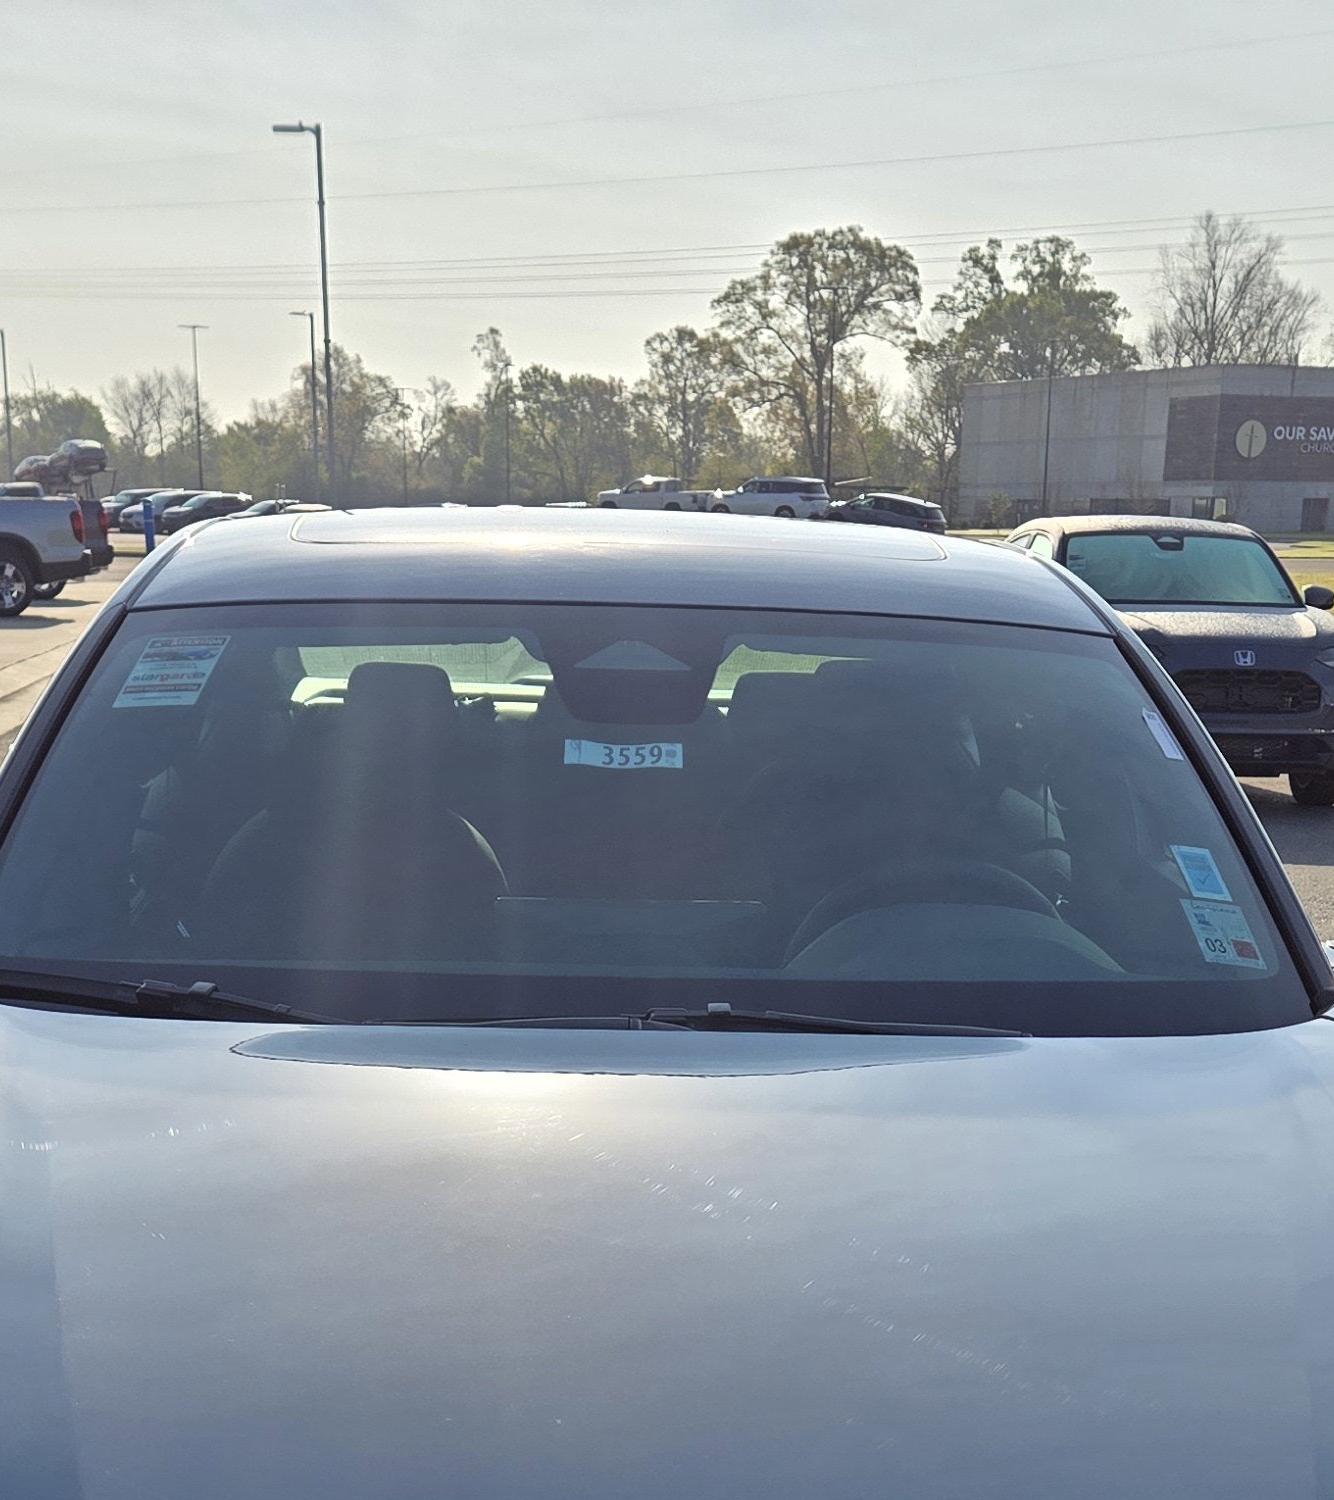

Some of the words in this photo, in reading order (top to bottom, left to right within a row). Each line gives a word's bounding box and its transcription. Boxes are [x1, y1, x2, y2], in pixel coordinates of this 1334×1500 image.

[1273, 425, 1305, 441] OUR
[601, 744, 664, 767] 3559
[1205, 936, 1228, 954] 03
